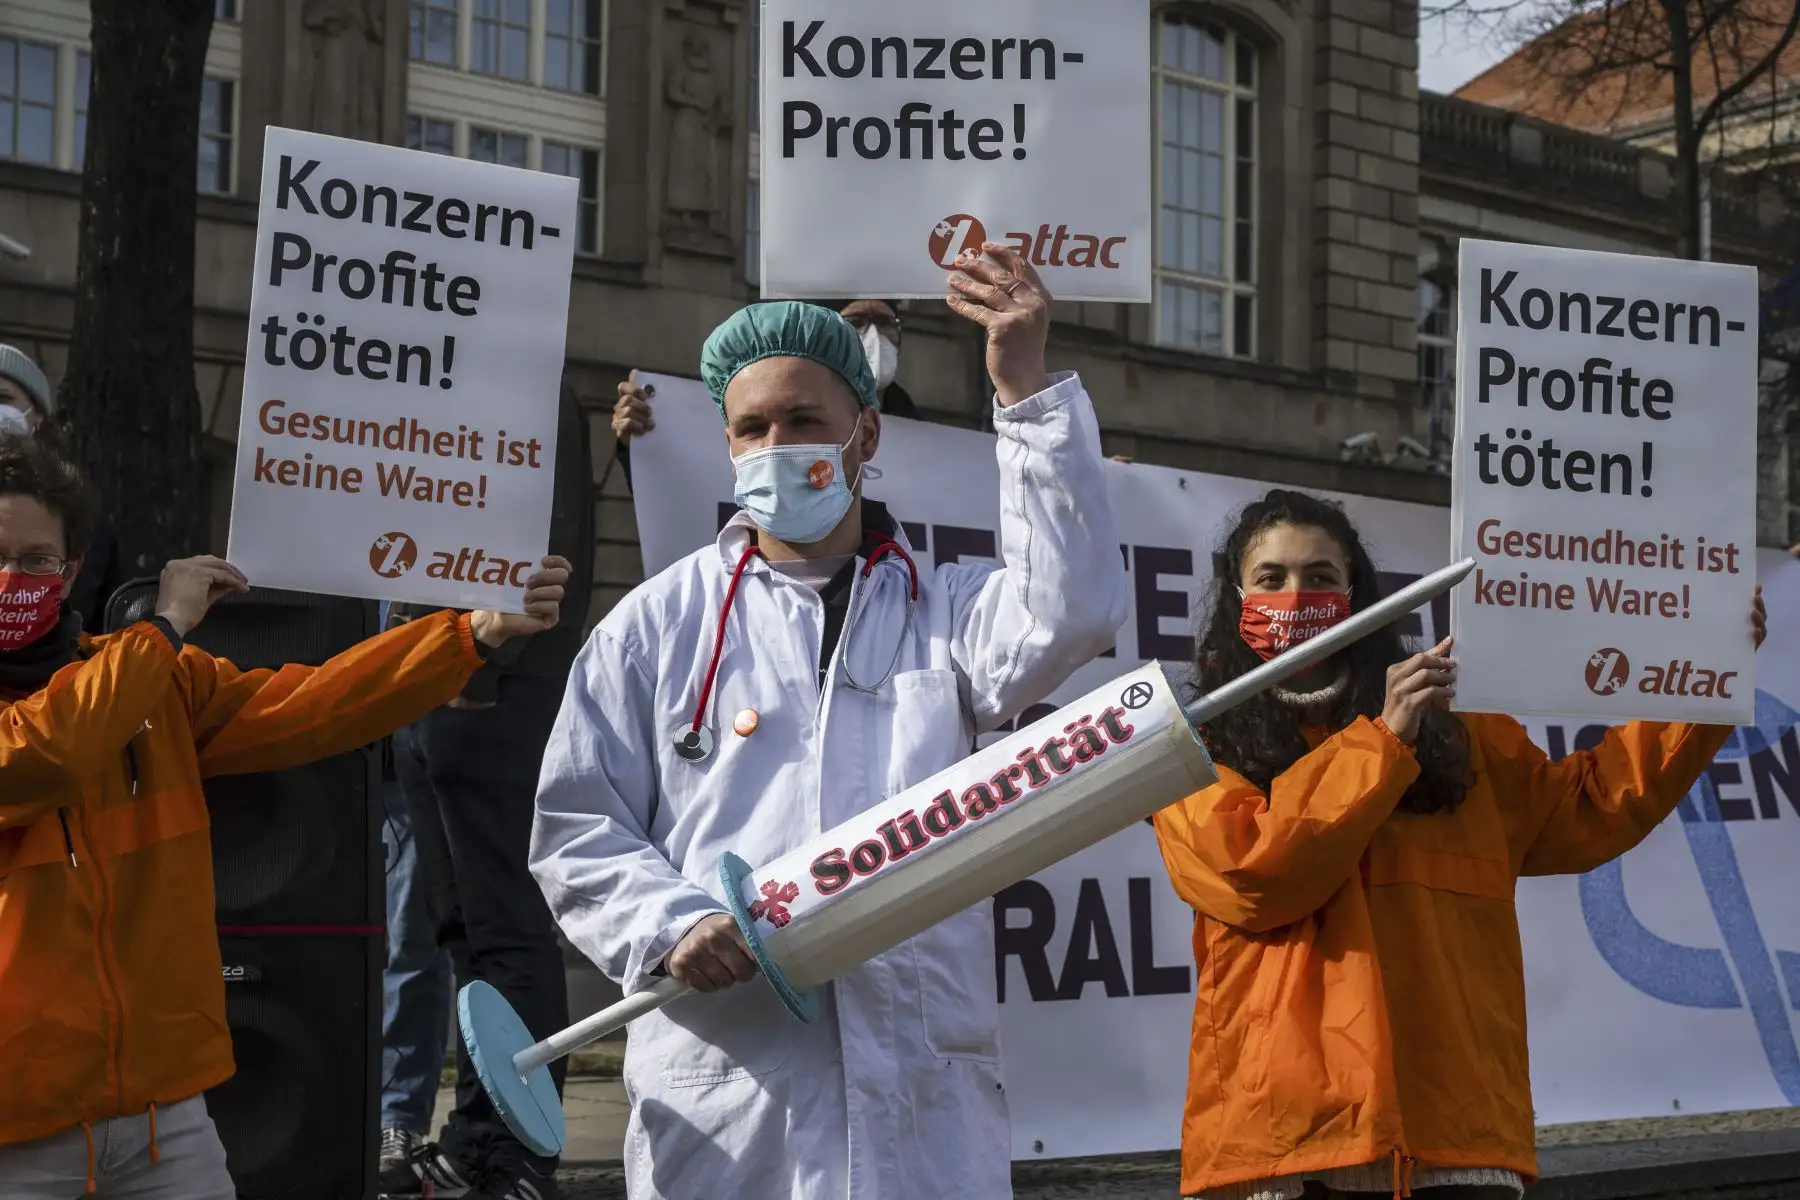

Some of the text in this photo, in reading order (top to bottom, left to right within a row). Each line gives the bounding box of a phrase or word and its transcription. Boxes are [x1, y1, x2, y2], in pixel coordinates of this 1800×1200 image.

[782, 20, 1084, 81] Konzern-
[782, 101, 1027, 161] Profite!
[276, 155, 561, 250] Konzern-
[270, 232, 482, 317] Profite
[1004, 223, 1127, 269] attac
[1479, 267, 1746, 347] Konzern-
[260, 312, 456, 390] töten!
[1478, 347, 1674, 421] Profite
[258, 399, 542, 469] Gesundheit ist
[1474, 427, 1653, 498] töten!
[253, 446, 487, 509] keine Ware!
[426, 547, 532, 588] attac
[1477, 518, 1740, 574] Gesundheit ist
[1474, 569, 1690, 619] keine Ware!
[1638, 659, 1739, 699] attac
[810, 705, 1135, 896] Solidarität
